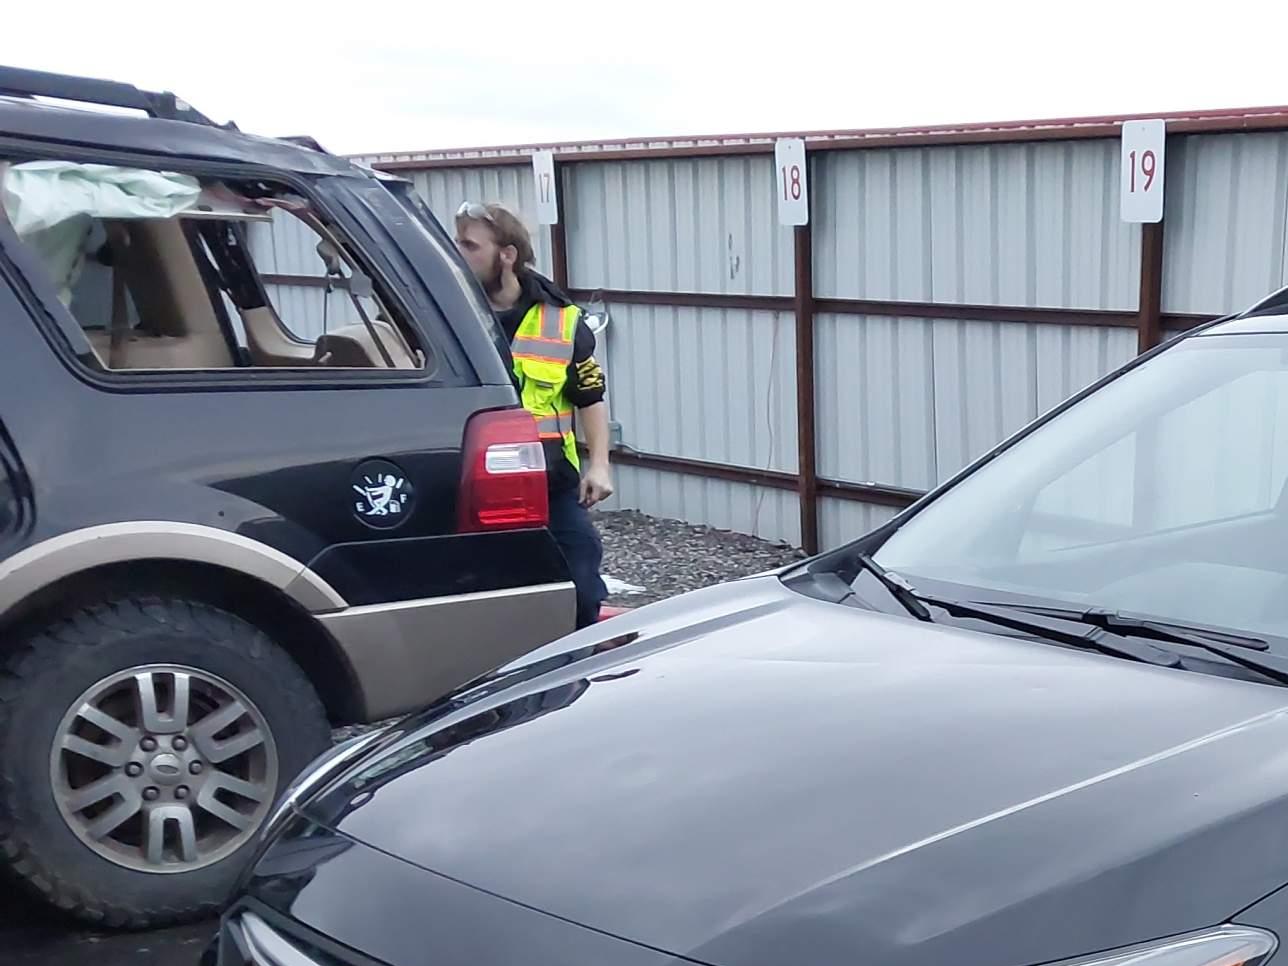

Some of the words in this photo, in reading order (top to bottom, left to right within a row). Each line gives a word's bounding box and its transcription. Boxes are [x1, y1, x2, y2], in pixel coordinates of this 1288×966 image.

[782, 165, 801, 200] 18
[1129, 150, 1156, 193] 19
[539, 172, 550, 204] 17
[356, 502, 365, 512] E
[400, 494, 407, 503] F
